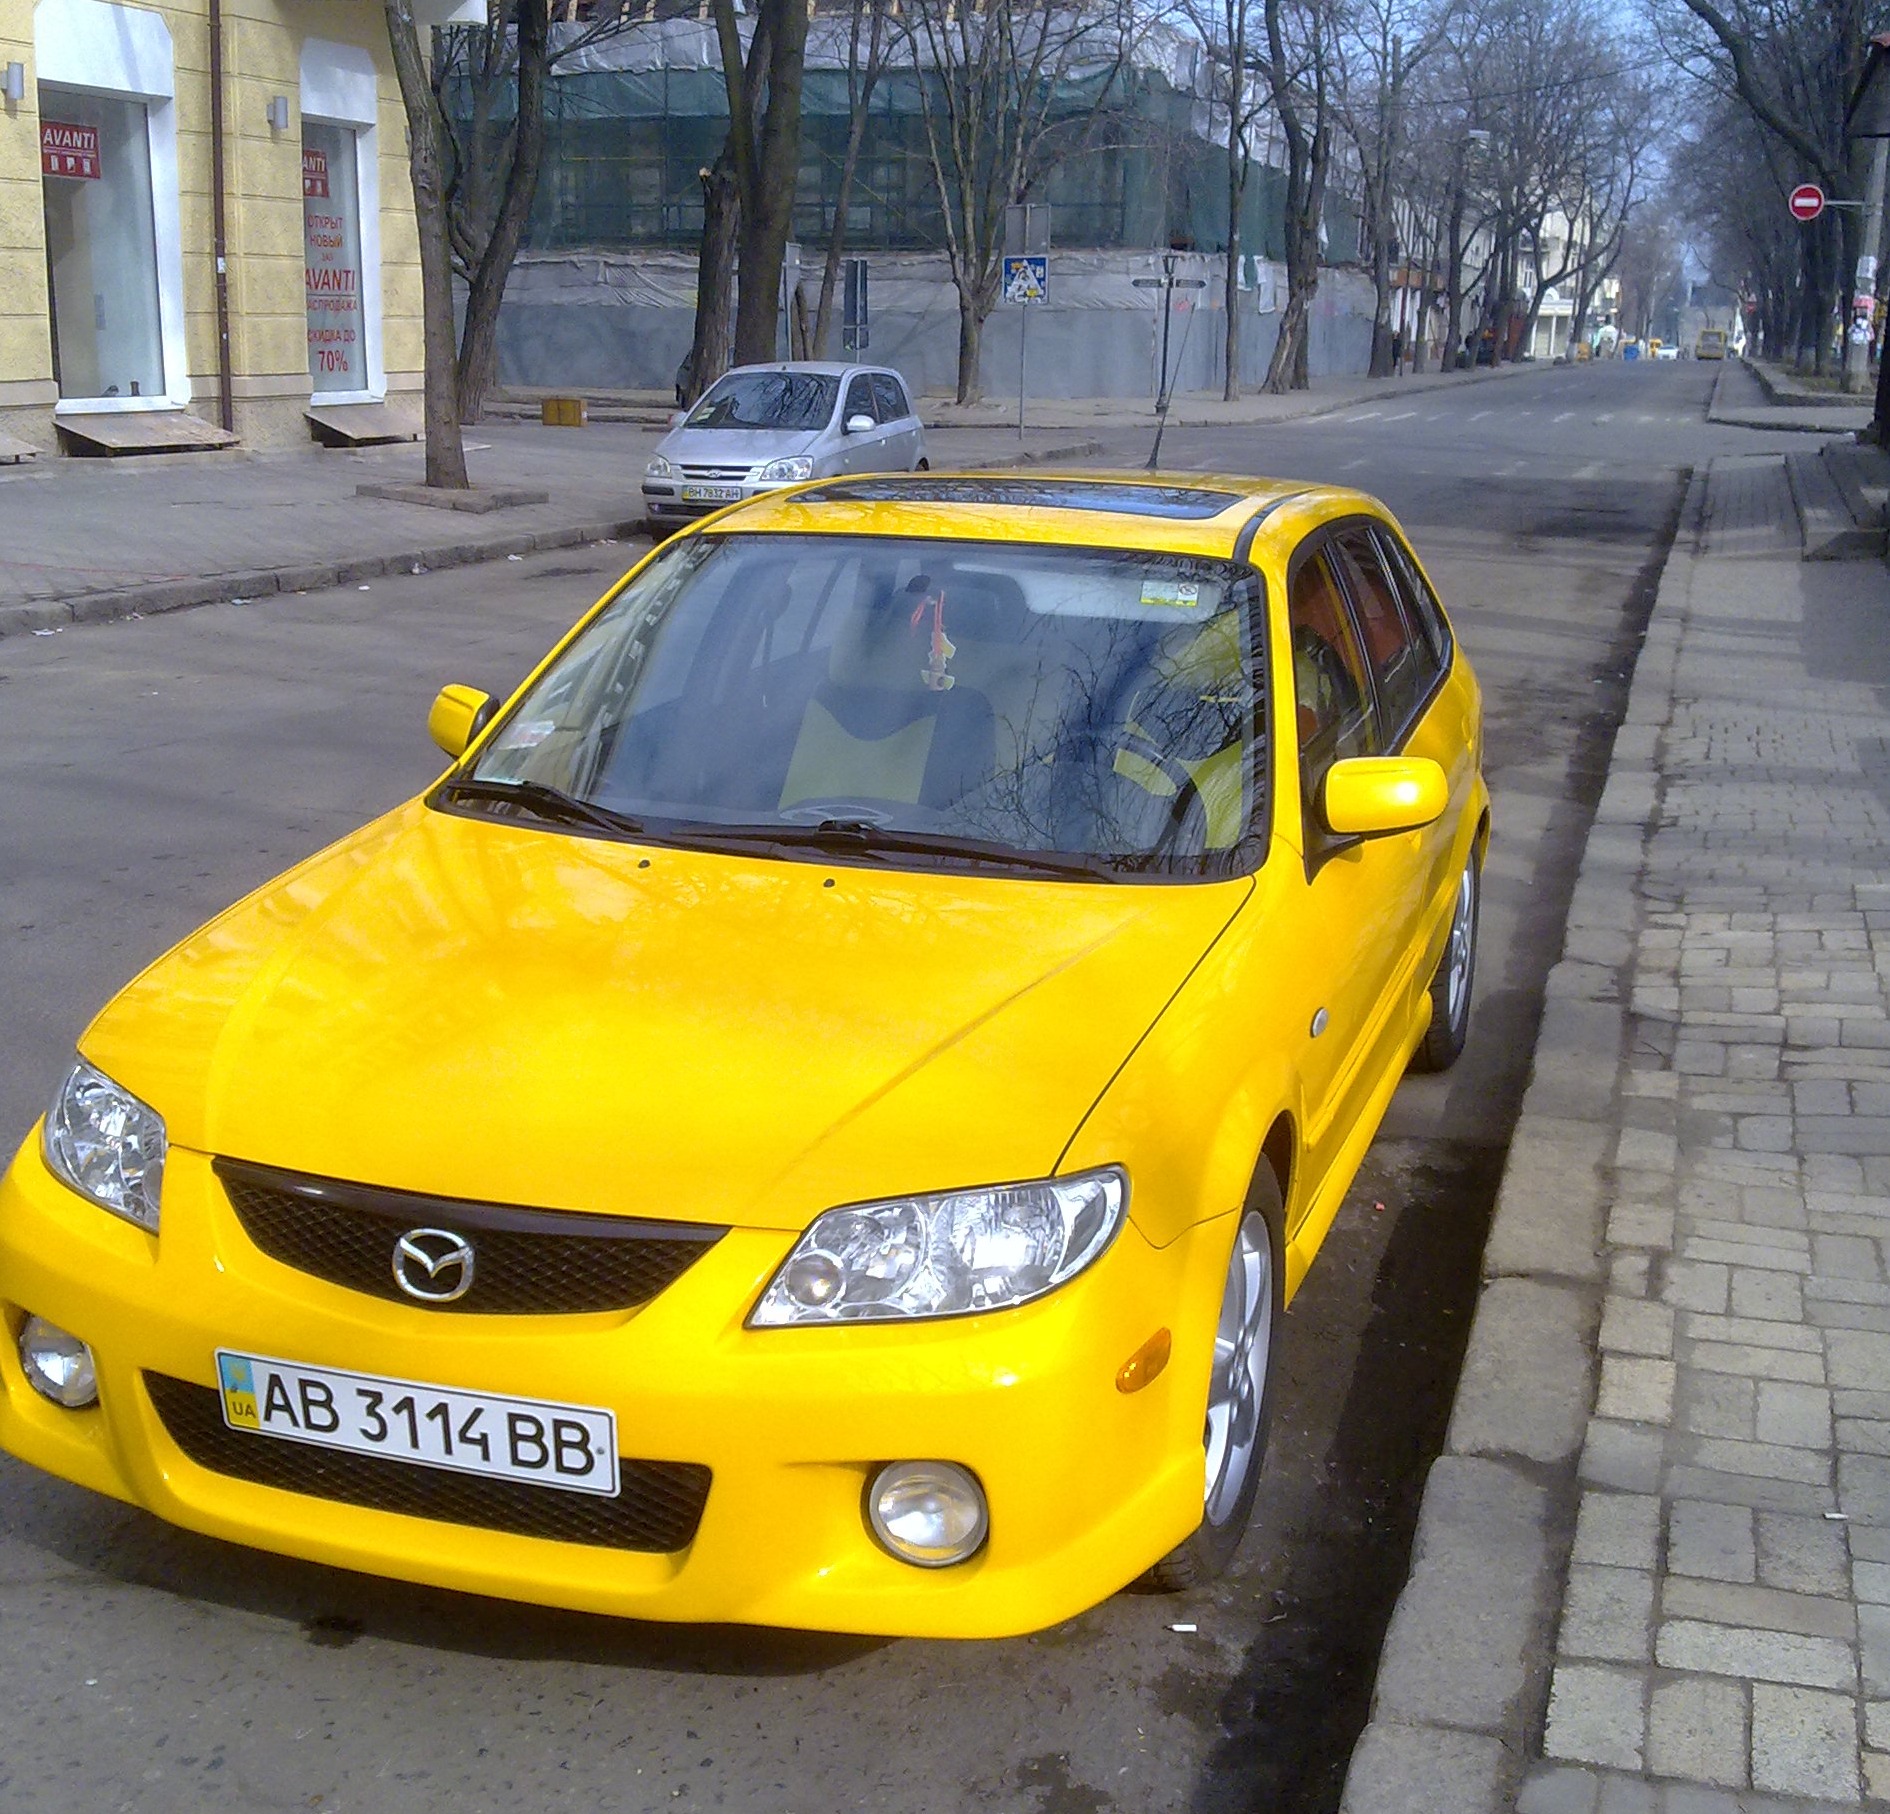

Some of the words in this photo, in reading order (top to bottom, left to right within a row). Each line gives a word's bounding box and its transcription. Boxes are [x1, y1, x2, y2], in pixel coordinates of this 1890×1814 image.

[43, 128, 95, 149] AVANTI
[307, 214, 343, 230] ОТКРЫТ
[310, 233, 343, 248] НОВЫЙ
[305, 267, 355, 292] AVANTI
[344, 329, 356, 343] ДО
[318, 349, 348, 372] 70%
[233, 1401, 256, 1419] UA
[264, 1373, 340, 1433] AB
[355, 1388, 490, 1462] 3114
[507, 1412, 595, 1476] BB
